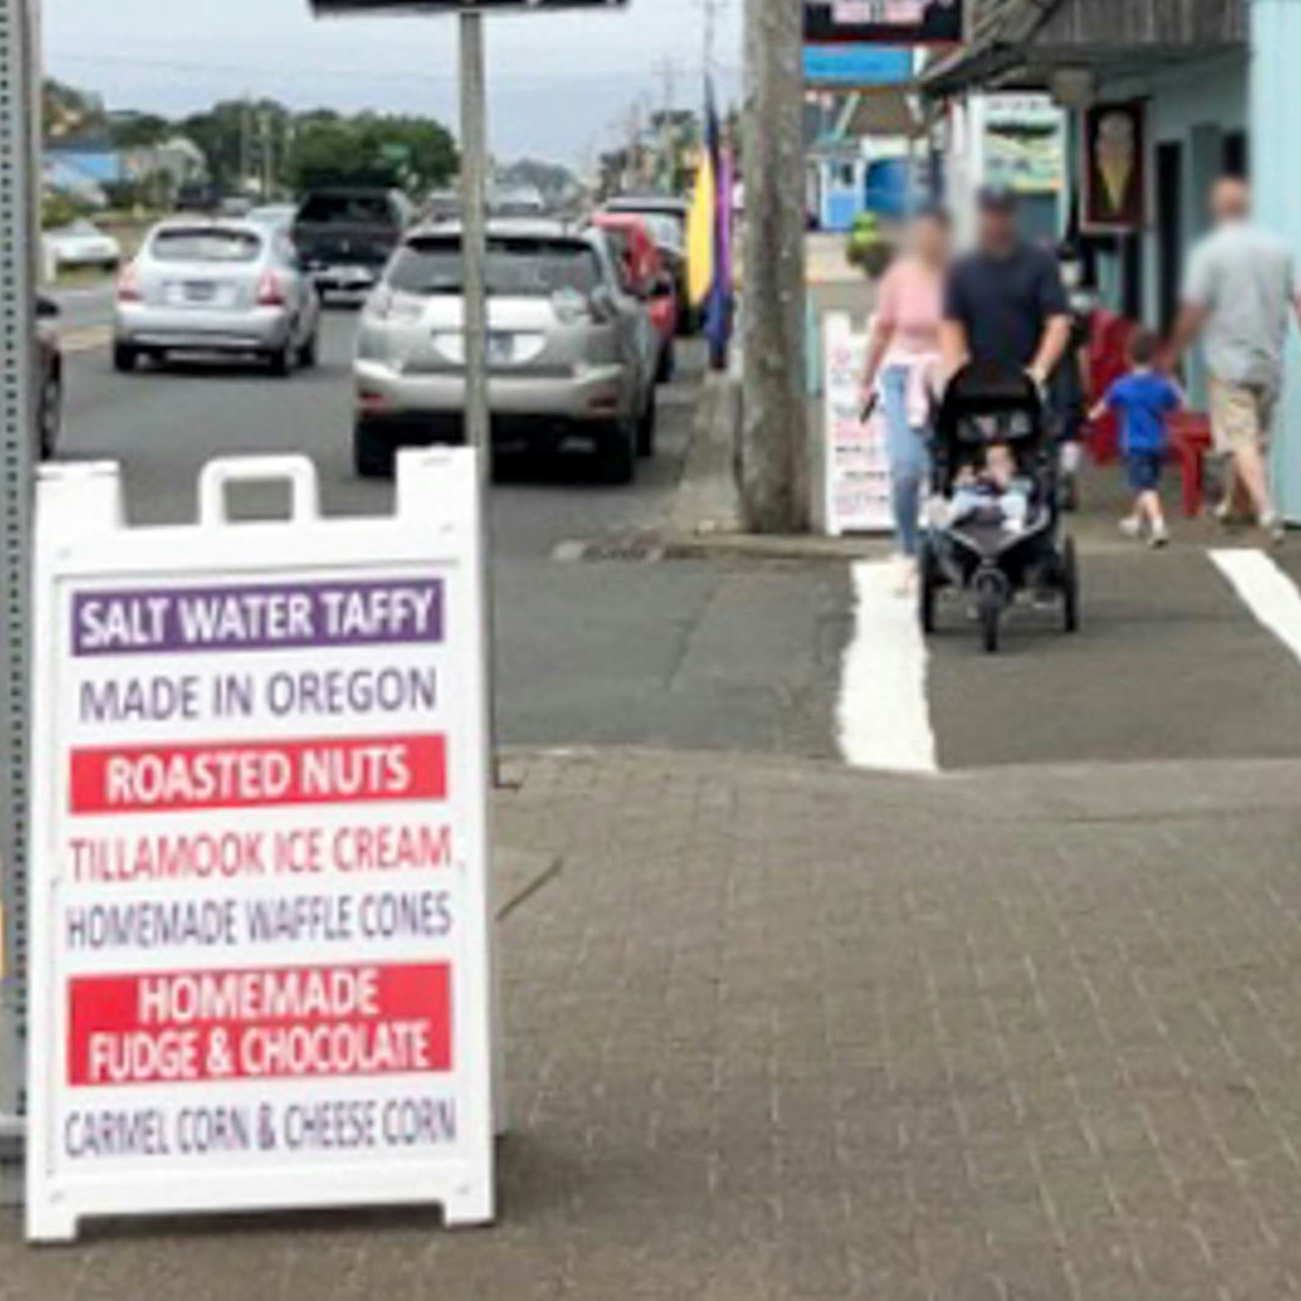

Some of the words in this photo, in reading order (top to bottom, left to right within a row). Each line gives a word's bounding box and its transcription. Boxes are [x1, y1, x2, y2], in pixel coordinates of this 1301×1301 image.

[80, 596, 170, 648] SALT
[179, 592, 315, 643] WATER
[321, 588, 435, 636] TAFFY
[79, 675, 201, 723] MADE
[213, 673, 253, 717] IN
[267, 666, 438, 717] OREGON
[106, 755, 291, 804] ROASTED
[303, 746, 411, 795] NUTS
[69, 831, 266, 883] TILLAMOOK
[274, 827, 323, 874] ICE
[333, 822, 453, 871] CREAM
[66, 900, 237, 950] HOMEMADE
[246, 894, 352, 943] WAFFLE
[359, 890, 452, 939] CONES
[137, 968, 380, 1023] HOMEMADE
[89, 1029, 199, 1082] FUDGE
[206, 1027, 233, 1074] &
[240, 1020, 431, 1073] CHOCOLATE
[65, 1107, 170, 1158] CARMEL
[178, 1105, 250, 1153] CORN
[258, 1102, 277, 1151] &
[284, 1100, 377, 1150] CHEESE
[382, 1096, 457, 1145] CORN
